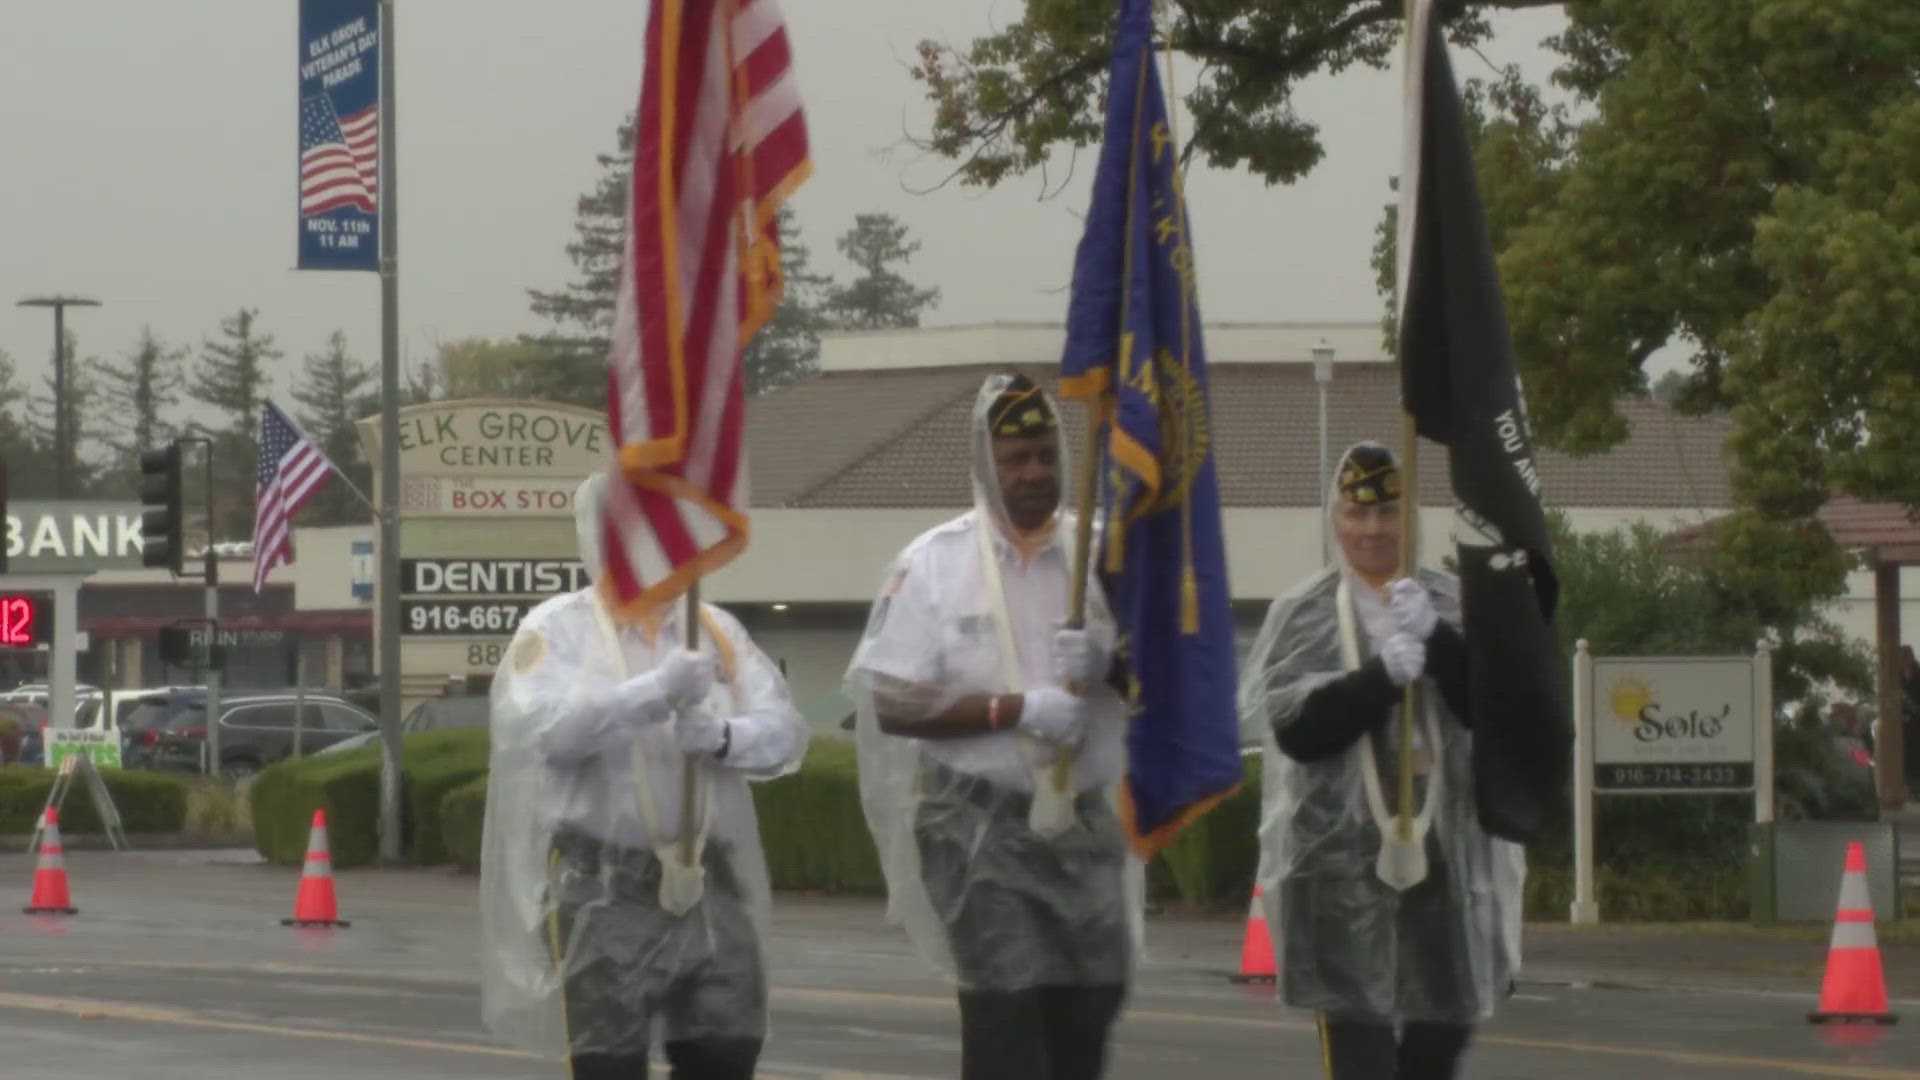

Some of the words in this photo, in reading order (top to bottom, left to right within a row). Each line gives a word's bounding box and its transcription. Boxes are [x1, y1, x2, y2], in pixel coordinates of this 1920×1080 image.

[309, 35, 330, 57] ELK
[332, 17, 366, 46] GROVE
[358, 31, 377, 52] DAY
[323, 58, 362, 88] PARADE
[307, 219, 337, 232] NOV.
[320, 234, 334, 247] 11
[338, 234, 359, 247] AM
[400, 414, 458, 451] ELK
[479, 412, 607, 453] GROVE
[1494, 408, 1524, 453] YOU
[440, 446, 554, 466] CENTER
[453, 490, 507, 509] BOX
[6, 514, 144, 557] BANK
[415, 561, 584, 592] DENTIST
[410, 605, 522, 630] 916-667
[467, 644, 508, 666] 88
